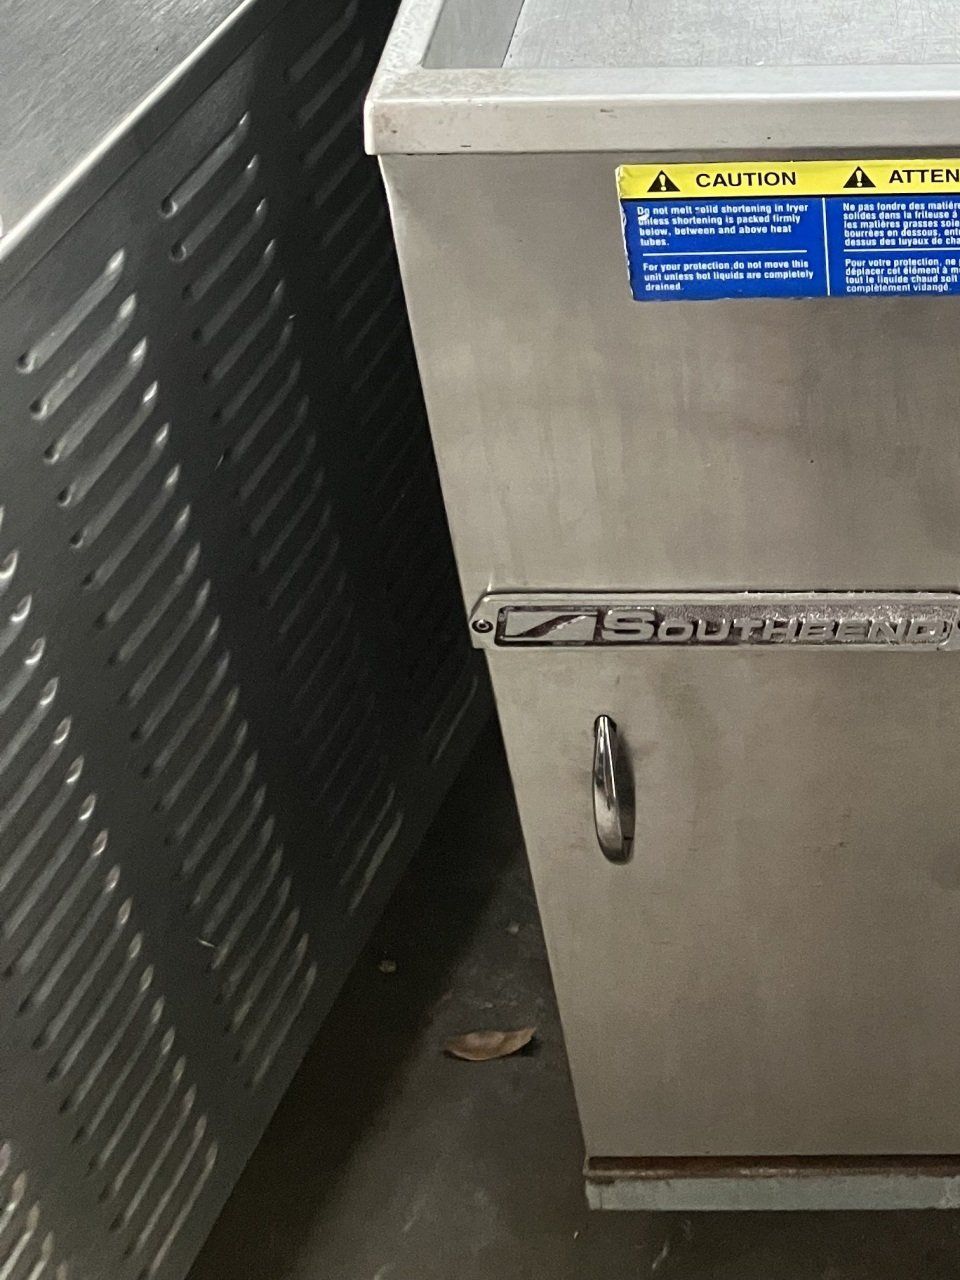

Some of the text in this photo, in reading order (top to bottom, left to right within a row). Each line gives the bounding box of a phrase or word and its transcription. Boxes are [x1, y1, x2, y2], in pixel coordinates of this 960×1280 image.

[695, 171, 797, 188] CAUTION
[637, 207, 650, 215] Do
[653, 206, 668, 214] not
[671, 206, 692, 214] melt
[721, 205, 771, 214] shortening
[774, 204, 783, 212] in
[786, 204, 808, 213] fryer
[843, 203, 855, 211] Ne
[858, 203, 875, 212] pas
[877, 202, 906, 210] fondre
[909, 202, 925, 210] des
[672, 216, 722, 225] shortening
[726, 215, 734, 223] is
[737, 215, 770, 225] packed
[773, 214, 800, 224] firmly
[843, 211, 876, 220] solides
[879, 211, 901, 220] dans
[903, 211, 912, 219] la
[915, 210, 950, 219] friteuse
[639, 224, 792, 236] below, between and above heat
[844, 220, 857, 228] les
[903, 220, 938, 230] grasses
[887, 229, 899, 237] en
[901, 228, 941, 237] dessous,
[640, 238, 670, 246] tubes.
[844, 238, 877, 246] dessus
[880, 238, 896, 246] des
[899, 237, 929, 247] tuyaux
[931, 237, 943, 245] de
[643, 263, 658, 271] For
[660, 263, 681, 272] your
[747, 261, 762, 269] not
[791, 260, 809, 268] this
[845, 259, 866, 267] Pour
[868, 259, 891, 267] votre
[893, 258, 942, 267] protection,
[644, 273, 661, 281] unit
[713, 271, 744, 280] liquids
[764, 270, 813, 280] completely
[845, 274, 958, 285] tout le liquide chaud soit
[645, 282, 684, 291] drained.
